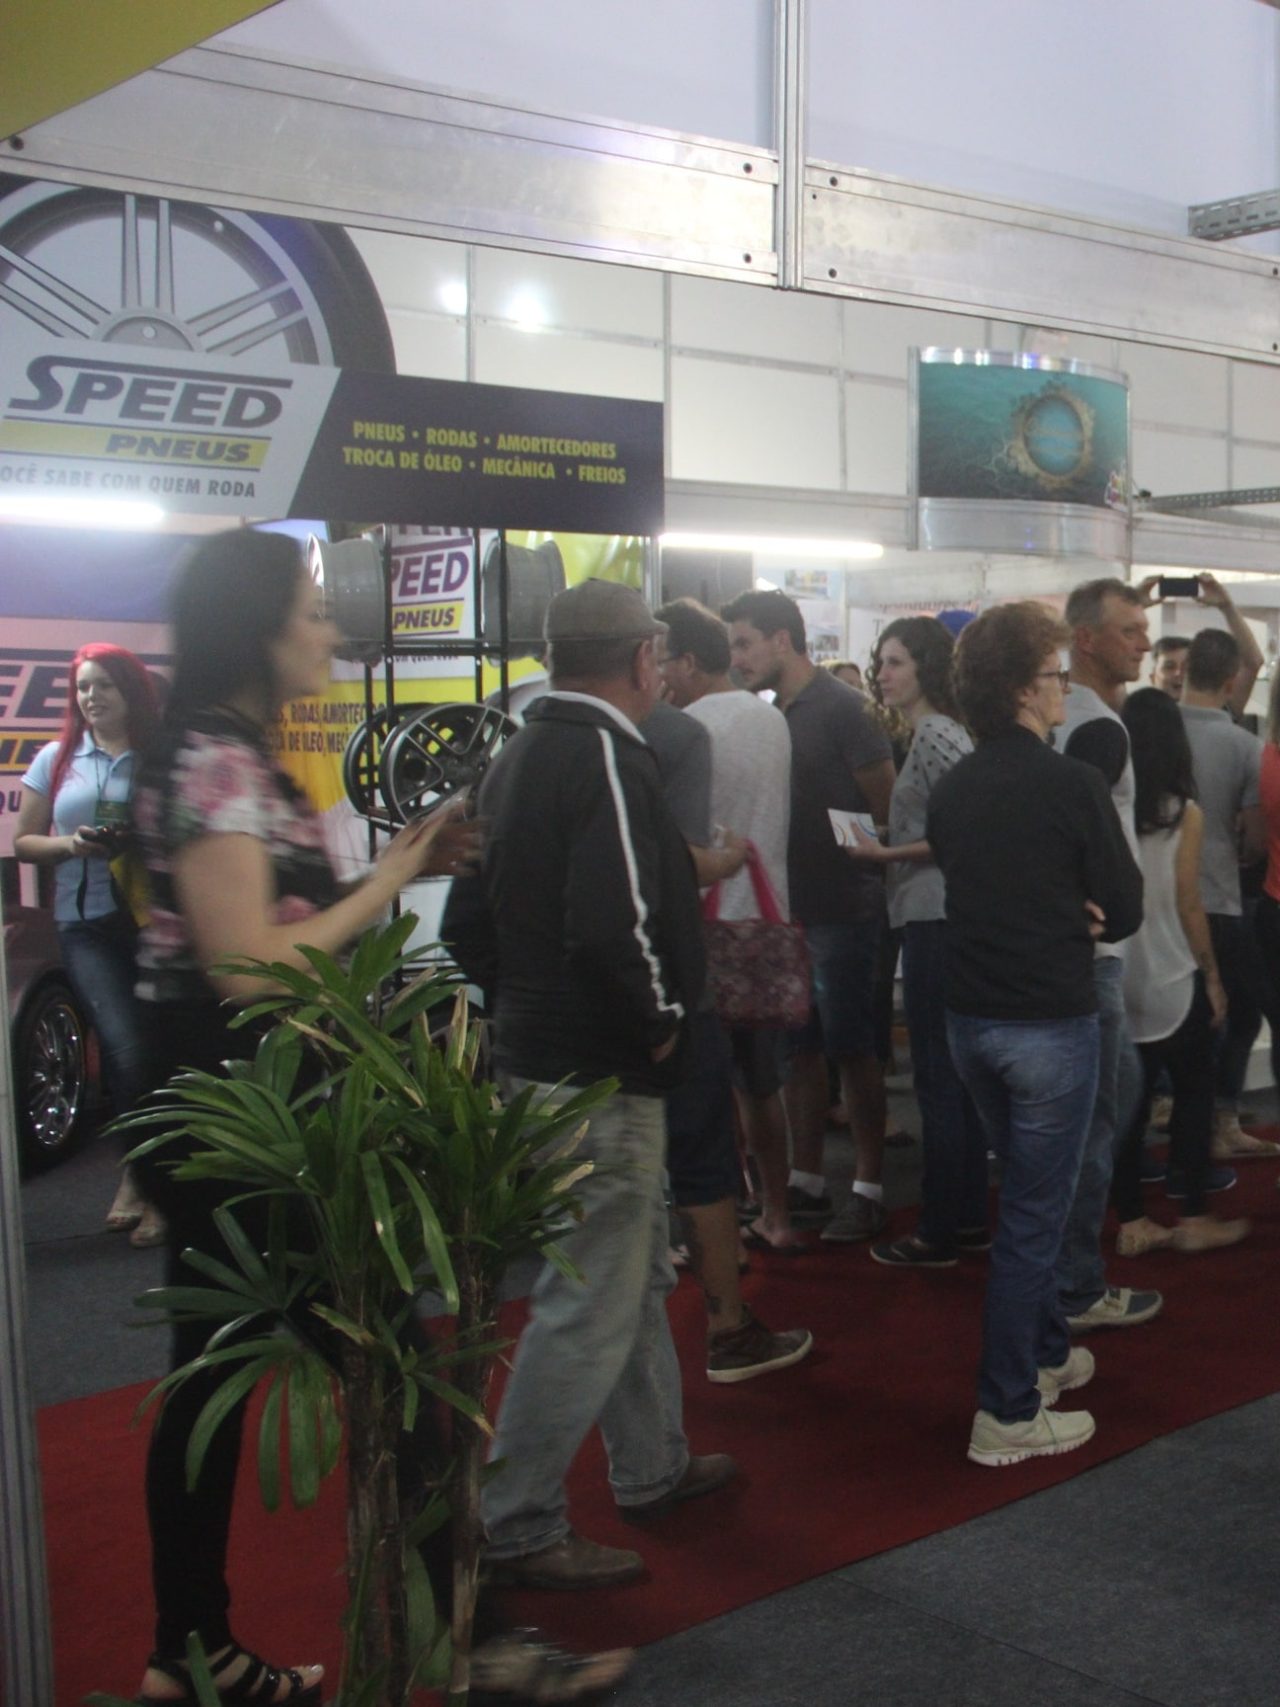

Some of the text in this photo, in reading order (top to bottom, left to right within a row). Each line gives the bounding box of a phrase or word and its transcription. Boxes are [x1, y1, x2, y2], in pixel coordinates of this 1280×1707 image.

[8, 355, 293, 428] SPEED
[105, 434, 251, 463] PNEUS
[353, 421, 617, 459] PNEUS RODAS AMORTECEDORES
[0, 463, 256, 498] OCÊ SABE COM QUEM RODA
[342, 446, 395, 468] TROCA
[400, 451, 419, 470] DE
[423, 449, 462, 473] ÓLEO
[578, 465, 626, 484] FREIOS
[393, 607, 455, 629] PNEUS
